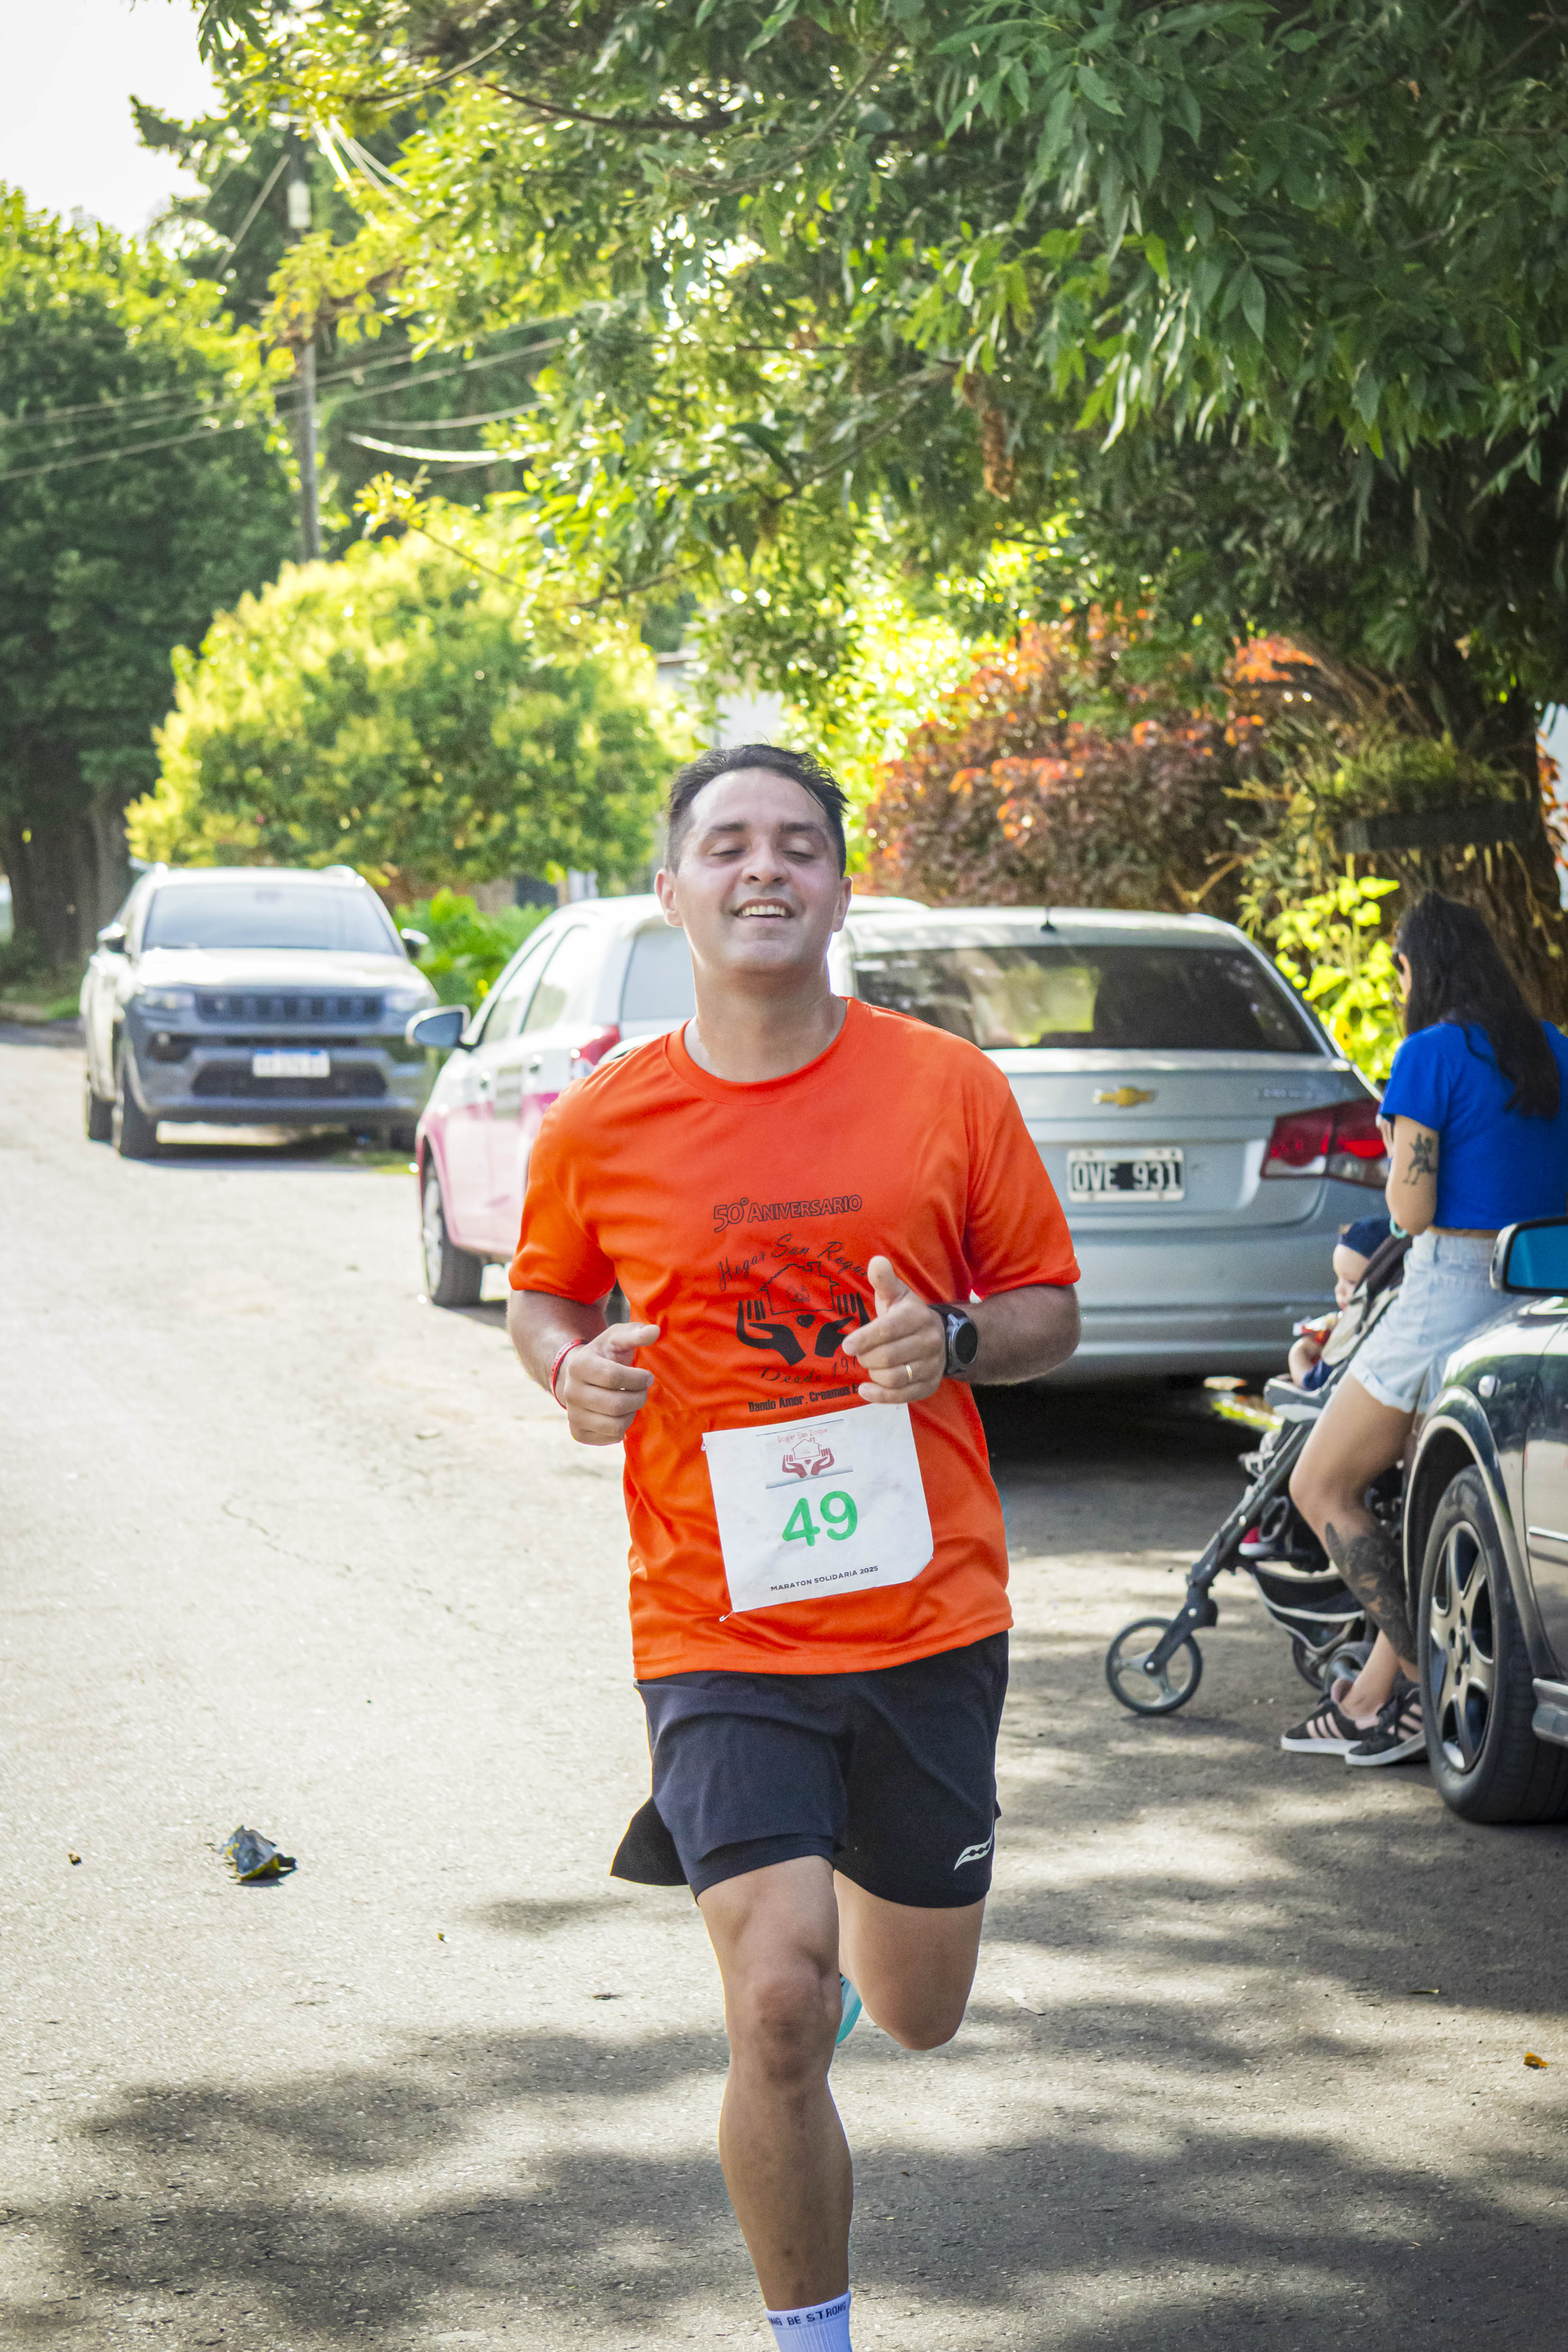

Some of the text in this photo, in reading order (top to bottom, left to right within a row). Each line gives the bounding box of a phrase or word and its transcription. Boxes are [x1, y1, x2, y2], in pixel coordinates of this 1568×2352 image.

[1073, 1161, 1179, 1190] OVE 931
[747, 1194, 862, 1223] ANIVERSARIO
[717, 1252, 765, 1291] Hogar
[772, 1234, 809, 1258] San
[761, 1366, 822, 1383] Desde
[748, 1399, 776, 1412] Dando
[809, 1386, 851, 1402] Creamos
[808, 1428, 828, 1437] Roque
[782, 1490, 858, 1547] 49
[770, 1565, 879, 1591] MARATON SOLIDARIA 2025
[787, 2316, 801, 2325] BE
[806, 2301, 846, 2322] STRONG
